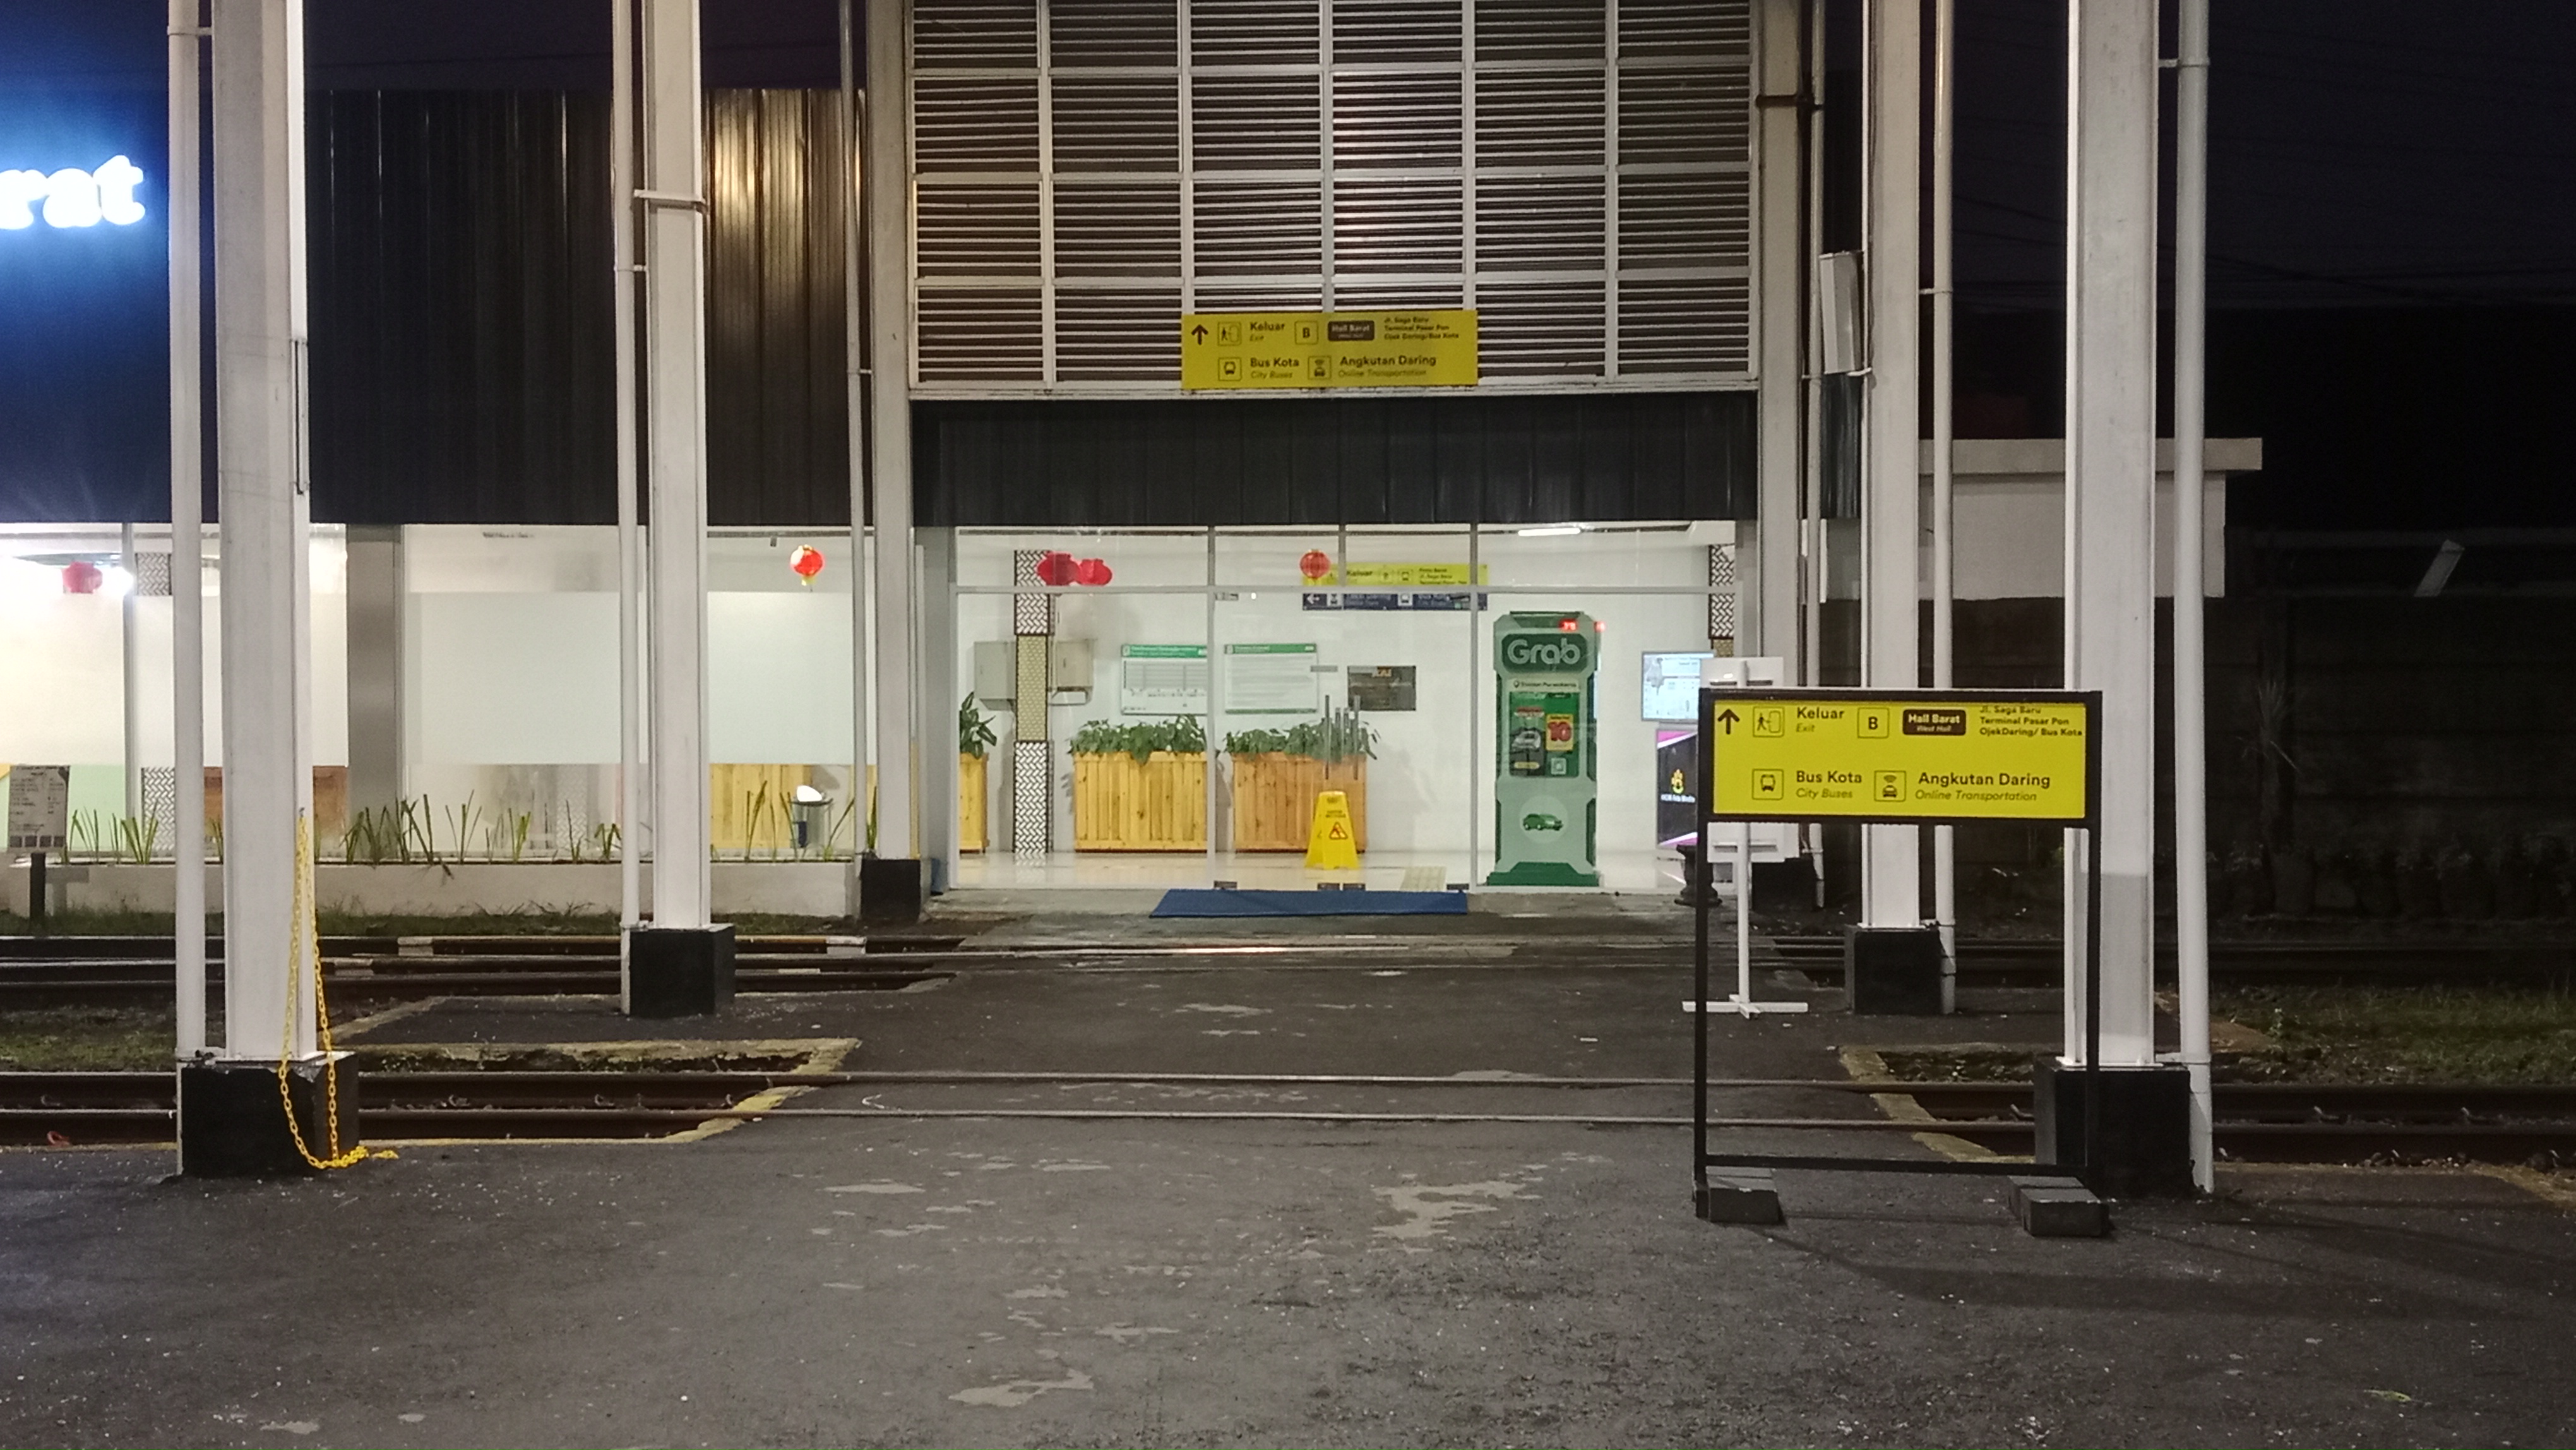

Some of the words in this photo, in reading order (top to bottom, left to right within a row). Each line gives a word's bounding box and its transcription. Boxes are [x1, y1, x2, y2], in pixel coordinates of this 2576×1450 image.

[1249, 321, 1285, 330] Keluar
[1303, 327, 1310, 338] B
[1250, 357, 1270, 367] Bus
[1273, 357, 1299, 367] Kota
[1340, 356, 1395, 368] Angkutan
[1398, 354, 1436, 366] Daring
[1507, 638, 1580, 664] Grab
[1797, 707, 1844, 719] Keluar
[1995, 705, 2017, 715] Saga
[1868, 716, 1878, 730] B
[1908, 714, 1929, 724] Hall
[1932, 714, 1960, 724] Barat
[1980, 716, 2021, 724] Terminal
[1796, 723, 1815, 733] Exit
[2061, 728, 2082, 736] Kota
[1796, 770, 1822, 783] Bus
[1828, 770, 1862, 783] Kota
[1918, 772, 1994, 788] Angkutan
[1999, 773, 2050, 789] Daring
[1796, 788, 1818, 800] City
[1822, 788, 1852, 798] Buses
[1915, 789, 1952, 800] Online
[1955, 790, 2037, 801] Transportation
